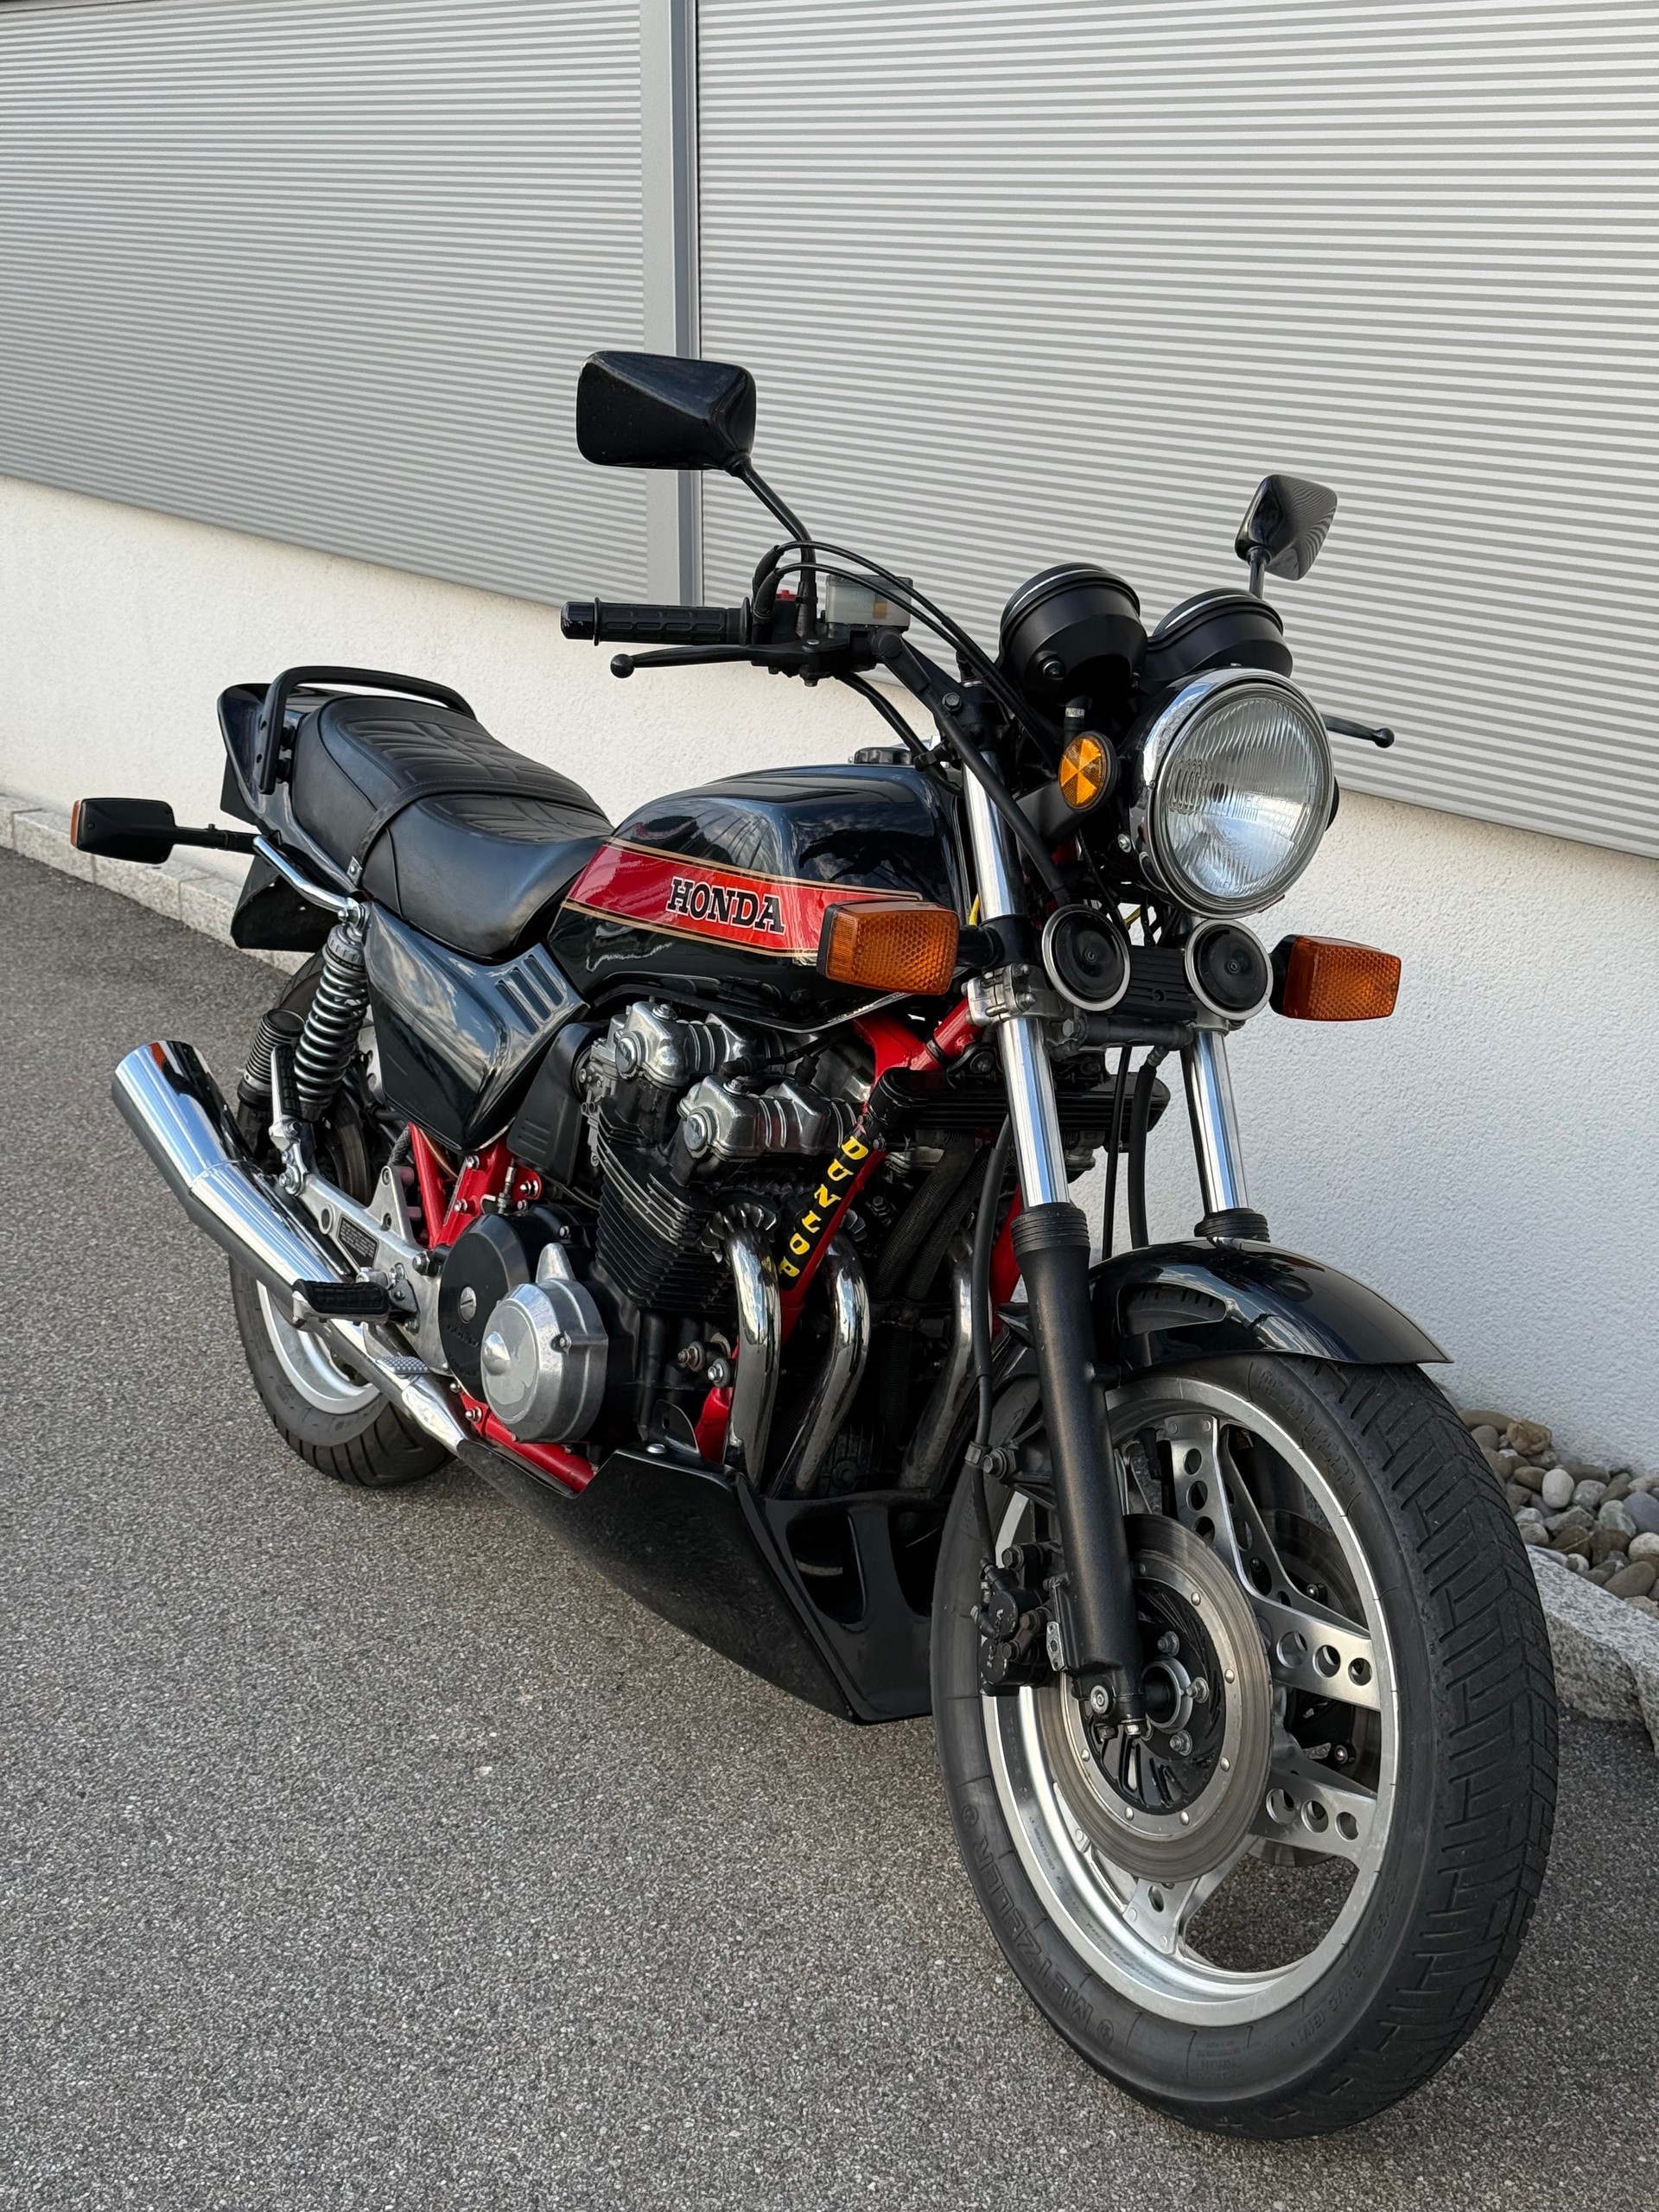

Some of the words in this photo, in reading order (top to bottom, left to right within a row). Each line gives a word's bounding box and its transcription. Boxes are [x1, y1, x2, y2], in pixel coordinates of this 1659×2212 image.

[665, 876, 786, 936] HONDA
[779, 1135, 869, 1277] DUNLOP
[972, 1834, 1095, 2031] METZELER
